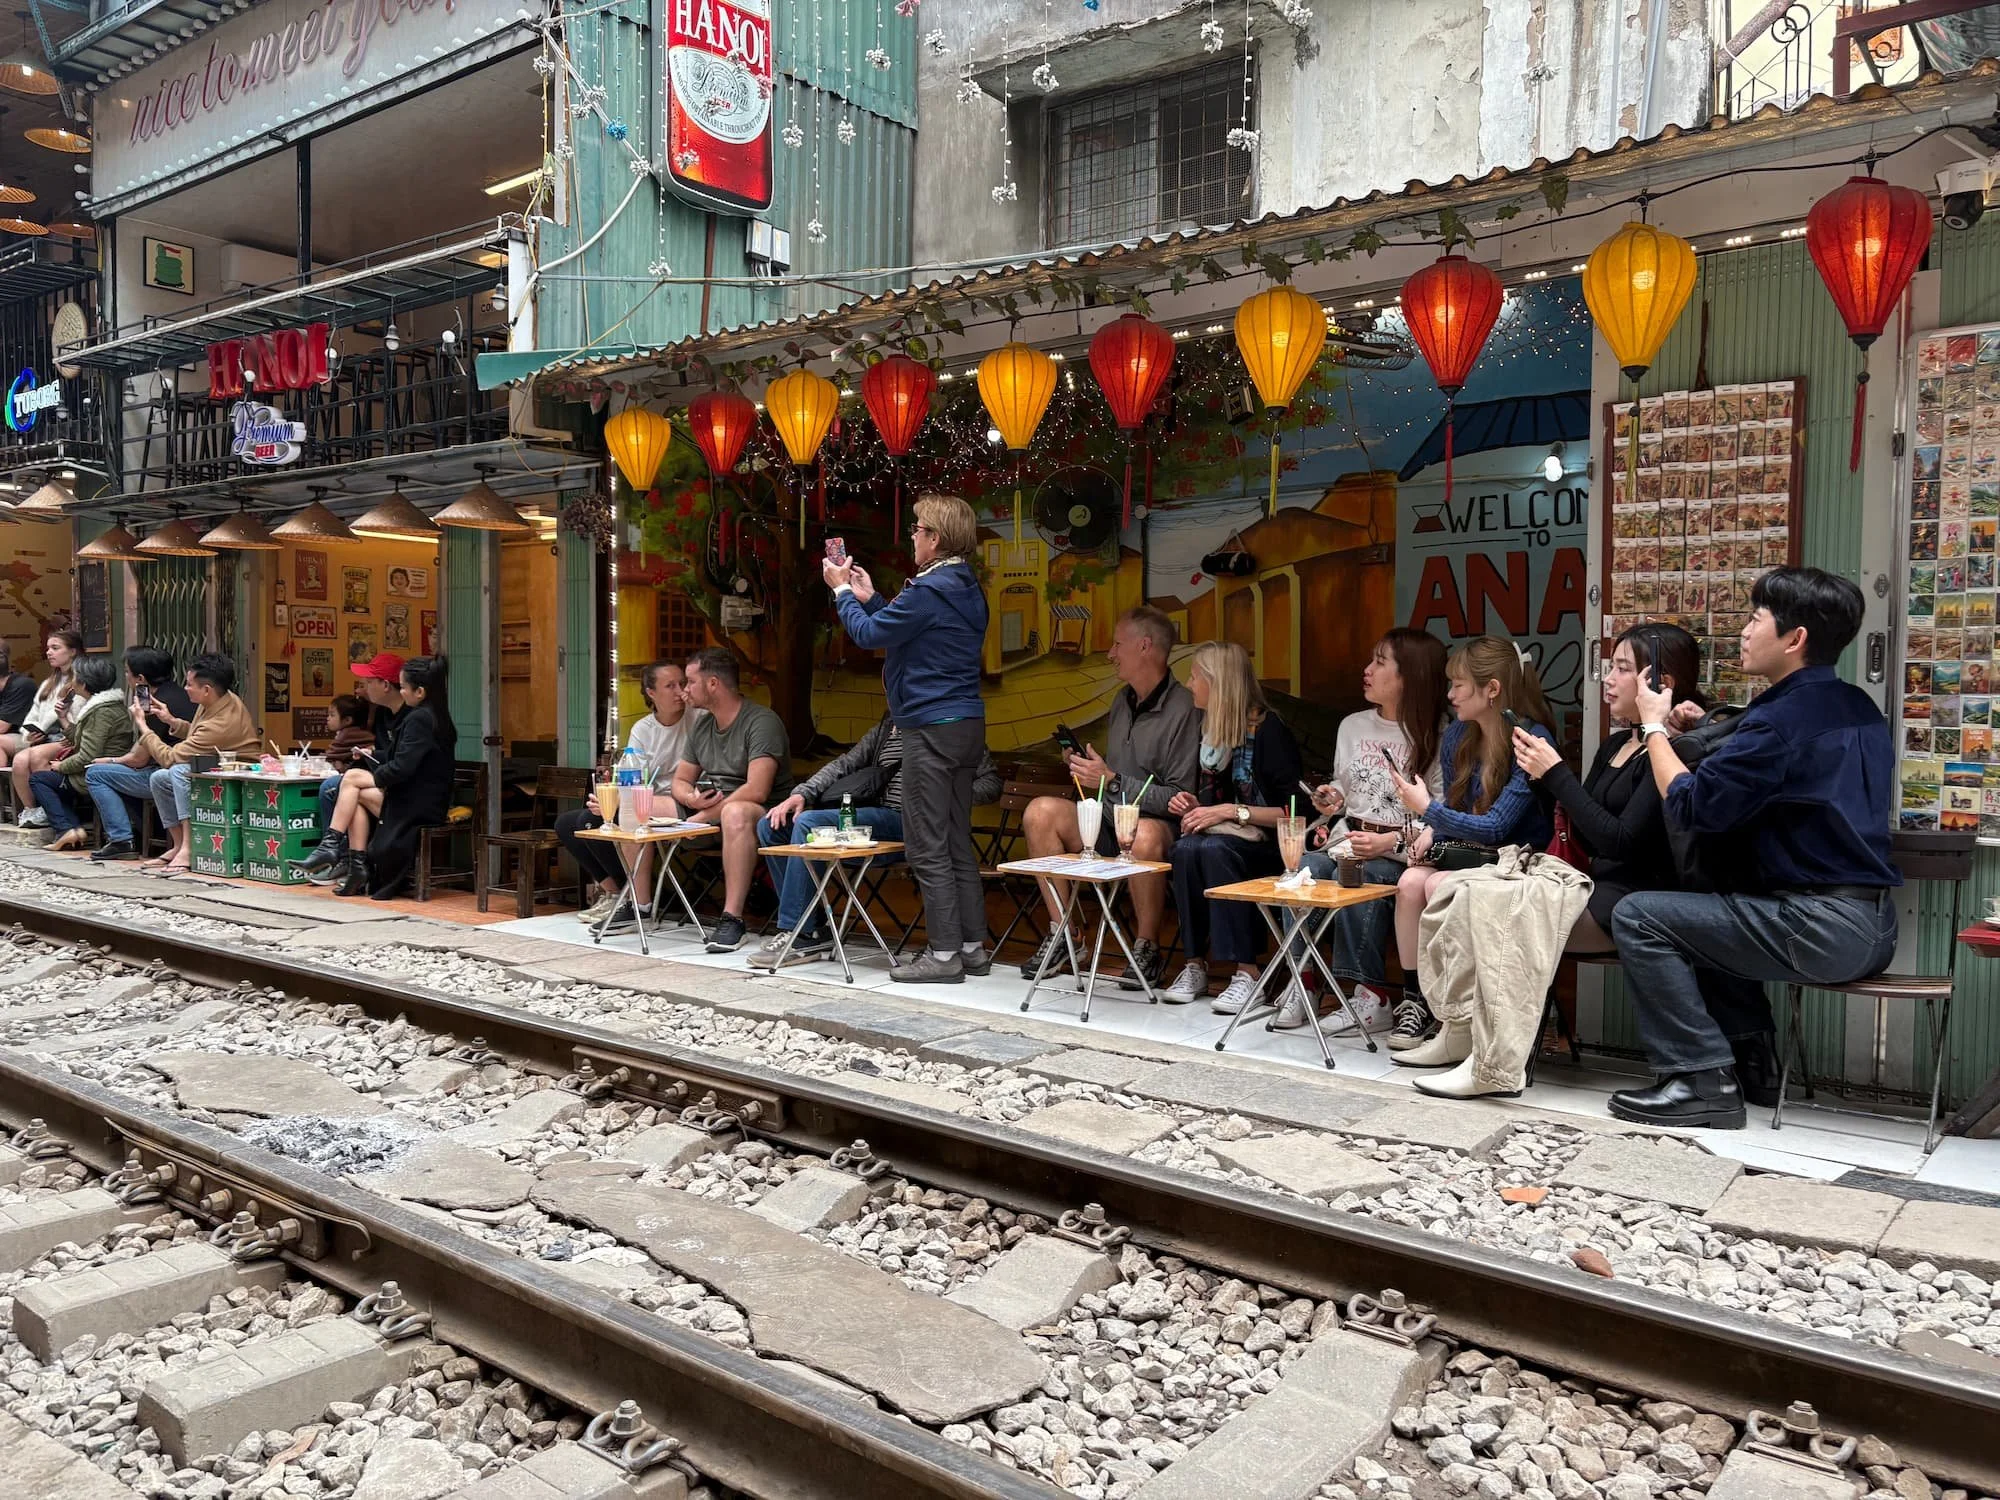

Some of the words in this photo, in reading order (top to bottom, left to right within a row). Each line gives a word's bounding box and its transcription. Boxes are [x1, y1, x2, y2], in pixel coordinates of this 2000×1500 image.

[675, 0, 765, 69] HANOI
[130, 72, 198, 146] nice
[201, 38, 238, 111] to
[242, 0, 344, 93] meet
[14, 379, 60, 418] TUBORG
[255, 444, 275, 457] BEER
[1523, 531, 1550, 547] TO
[296, 620, 335, 636] OPEN
